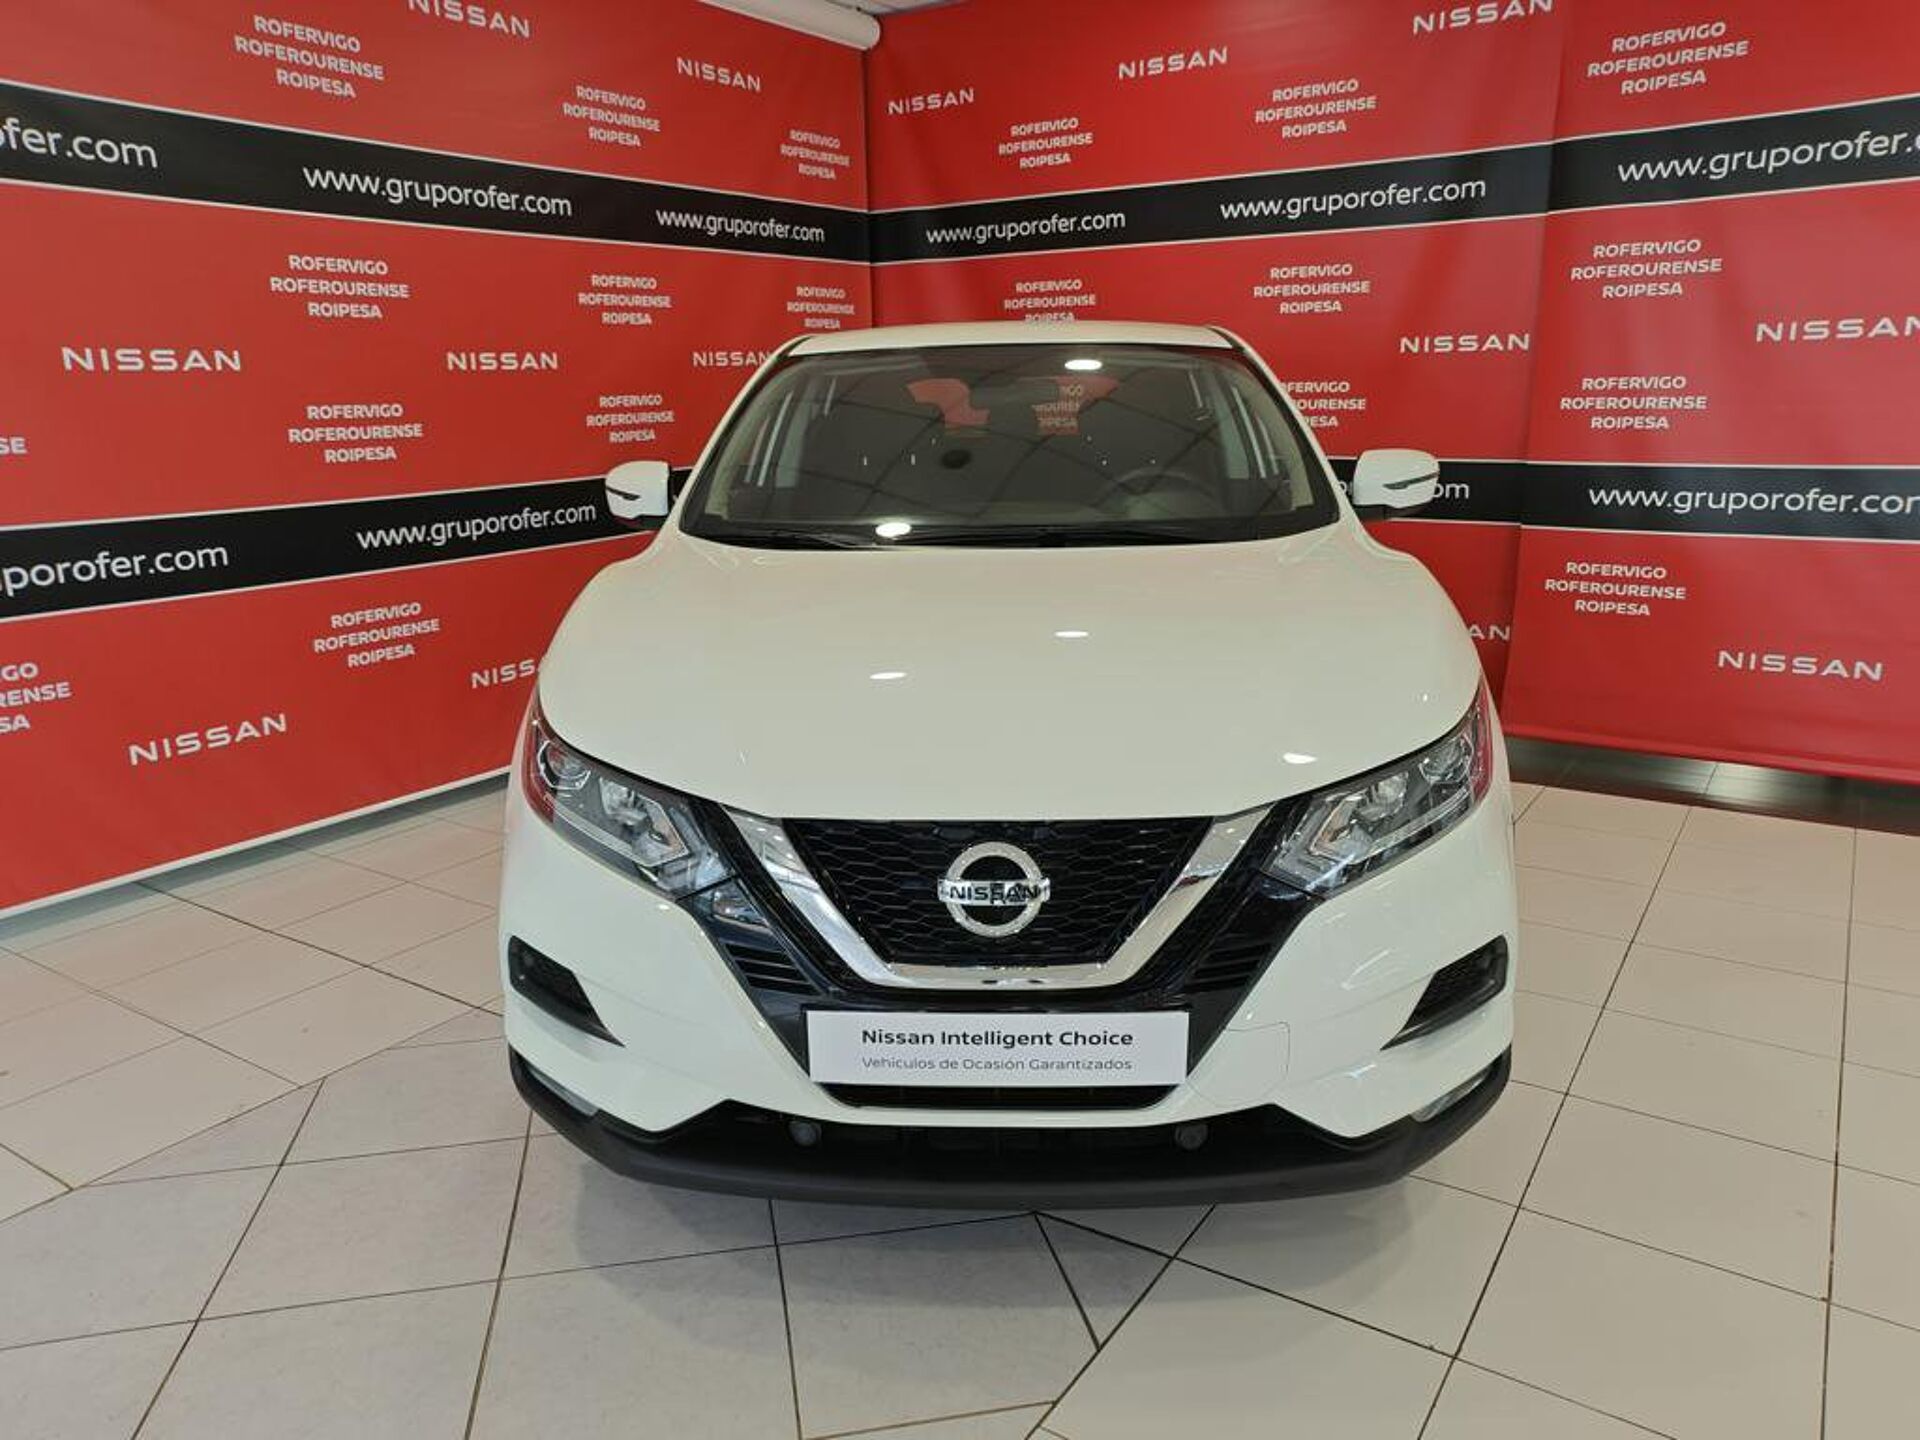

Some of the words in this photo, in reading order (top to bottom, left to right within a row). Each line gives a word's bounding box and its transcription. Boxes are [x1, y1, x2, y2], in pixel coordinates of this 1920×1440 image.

[409, 0, 529, 38] NISSAN
[1413, 0, 1552, 34] NISSAN
[255, 15, 360, 53] ROFERVIGO
[1612, 22, 1726, 52] ROFERVIGO
[235, 36, 383, 80] ROFEROURENSE
[1119, 47, 1227, 79] NISSAN
[1588, 41, 1748, 77] ROFEROURENSE
[277, 69, 356, 97] ROIPESA
[677, 57, 760, 91] NISSAN
[1622, 70, 1706, 94] ROIPESA
[576, 86, 645, 110] ROFERVIGO
[889, 88, 974, 114] NISSAN
[1273, 79, 1358, 102] ROFERVIGO
[563, 102, 660, 131] ROFEROURENSE
[1256, 96, 1376, 122] ROFEROURENSE
[589, 127, 640, 146] ROIPESA
[1011, 117, 1078, 136] ROFERVIGO
[1282, 120, 1346, 138] ROIPESA
[0, 118, 157, 168] fer.com
[999, 133, 1092, 154] ROFEROURENSE
[1020, 153, 1071, 168] ROIPESA
[1618, 131, 1920, 181] www.gruporofer.
[303, 168, 571, 216] www.gruporofer.com
[1221, 181, 1485, 219] www.gruporofer.com
[656, 210, 824, 241] www.gruporofer.com
[926, 213, 1125, 244] www.gruporofer.com
[1594, 239, 1701, 258] ROFERVIGO
[289, 255, 388, 275] ROFERVIGO
[1270, 264, 1352, 279] ROFERVIGO
[1571, 259, 1722, 279] ROFEROURENSE
[270, 277, 409, 298] ROFEROURENSE
[591, 274, 657, 289] ROFERVIGO
[1016, 279, 1082, 293] ROFERVIGO
[1254, 281, 1370, 297] ROFEROURENSE
[1603, 282, 1682, 298] ROIPESA
[308, 302, 382, 318] ROIPESA
[578, 293, 671, 308] ROFEROURENSE
[1004, 294, 1096, 309] ROFEROURENSE
[1280, 300, 1342, 314] ROIPESA
[602, 312, 652, 325] ROIPESA
[1757, 316, 1920, 341] NISSAN
[1401, 334, 1529, 352] NISSAN
[62, 347, 240, 371] NISSAN
[447, 352, 557, 370] NISSAN
[1582, 376, 1686, 390] ROFERVIGO
[307, 404, 403, 420] ROFERVIGO
[600, 395, 662, 408] ROFERVIGO
[1561, 396, 1707, 409] ROFEROURENSE
[587, 411, 674, 426] ROFEROURENSE
[1591, 416, 1669, 429] ROIPESA
[288, 424, 422, 442] ROFEROURENSE
[609, 429, 655, 442] ROIPESA
[325, 446, 396, 463] ROIPESA
[357, 505, 596, 549] www.gruporofer.com
[0, 547, 228, 596] porofer.com
[1567, 562, 1666, 579] ROFERVIGO
[1545, 579, 1686, 599] ROFEROURENSE
[331, 602, 421, 628] ROFERVIGO
[1575, 600, 1650, 615] ROIPESA
[314, 619, 439, 652] ROFEROURENSE
[348, 644, 415, 667] ROIPESA
[1719, 651, 1882, 680] NISSAN
[472, 659, 538, 689] NISS
[129, 714, 286, 765] NISSAN
[950, 883, 1041, 903] NISSAN
[862, 1029, 935, 1046] Nissan
[941, 1030, 1053, 1050] Intelligent
[1059, 1030, 1134, 1046] Choice
[939, 1057, 960, 1070] de
[1029, 1058, 1133, 1071] Garantizados
